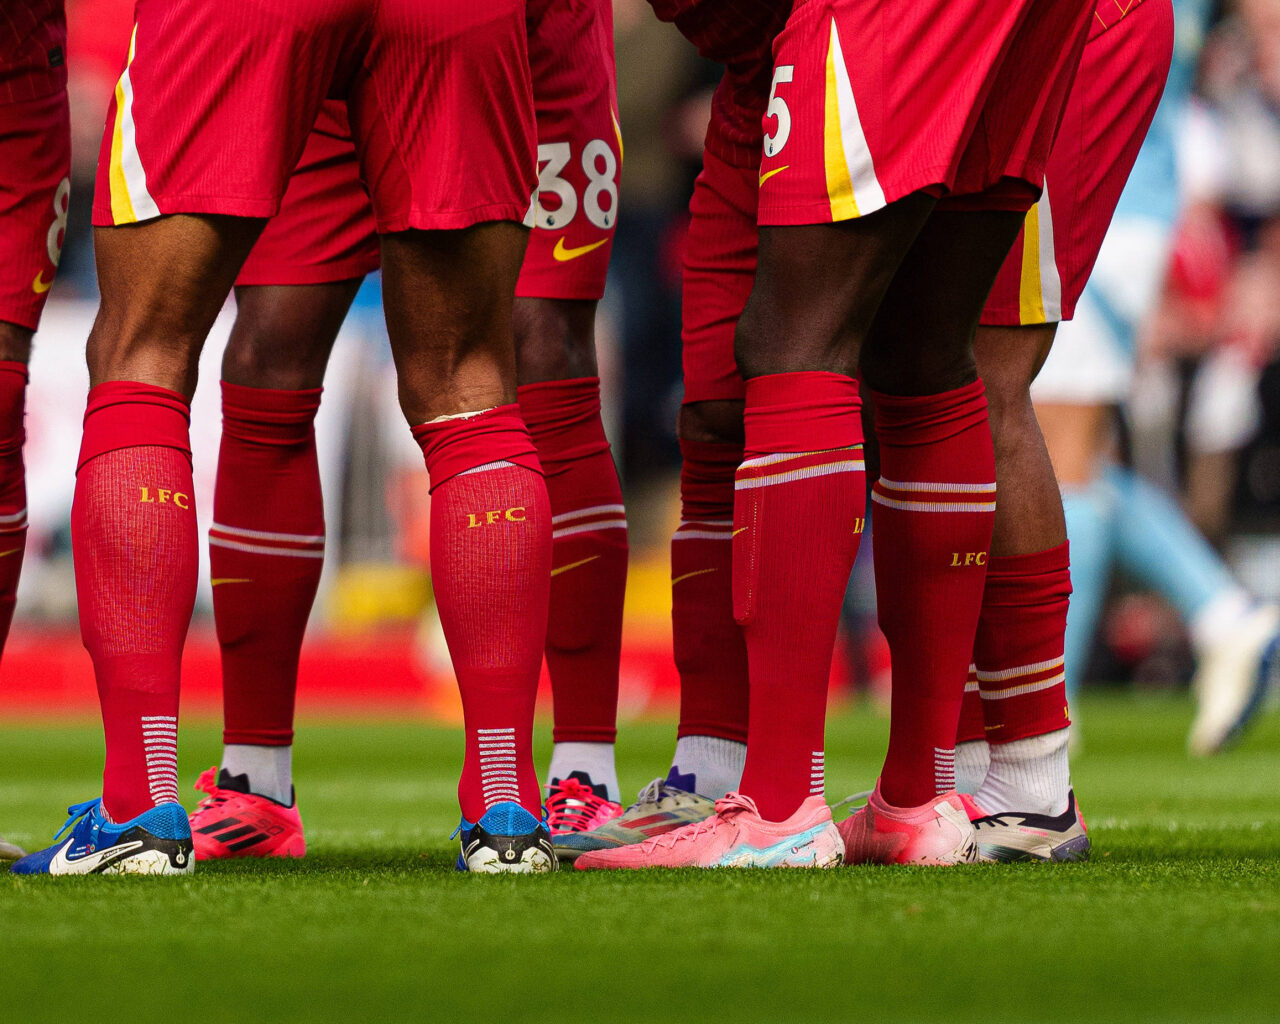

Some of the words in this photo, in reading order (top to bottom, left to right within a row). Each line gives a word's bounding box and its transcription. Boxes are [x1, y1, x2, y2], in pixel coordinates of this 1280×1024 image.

[763, 65, 795, 158] 5
[536, 139, 618, 230] 38
[47, 177, 71, 267] 8
[140, 486, 189, 510] LFC
[467, 506, 527, 528] LFC
[950, 551, 987, 567] LFC
